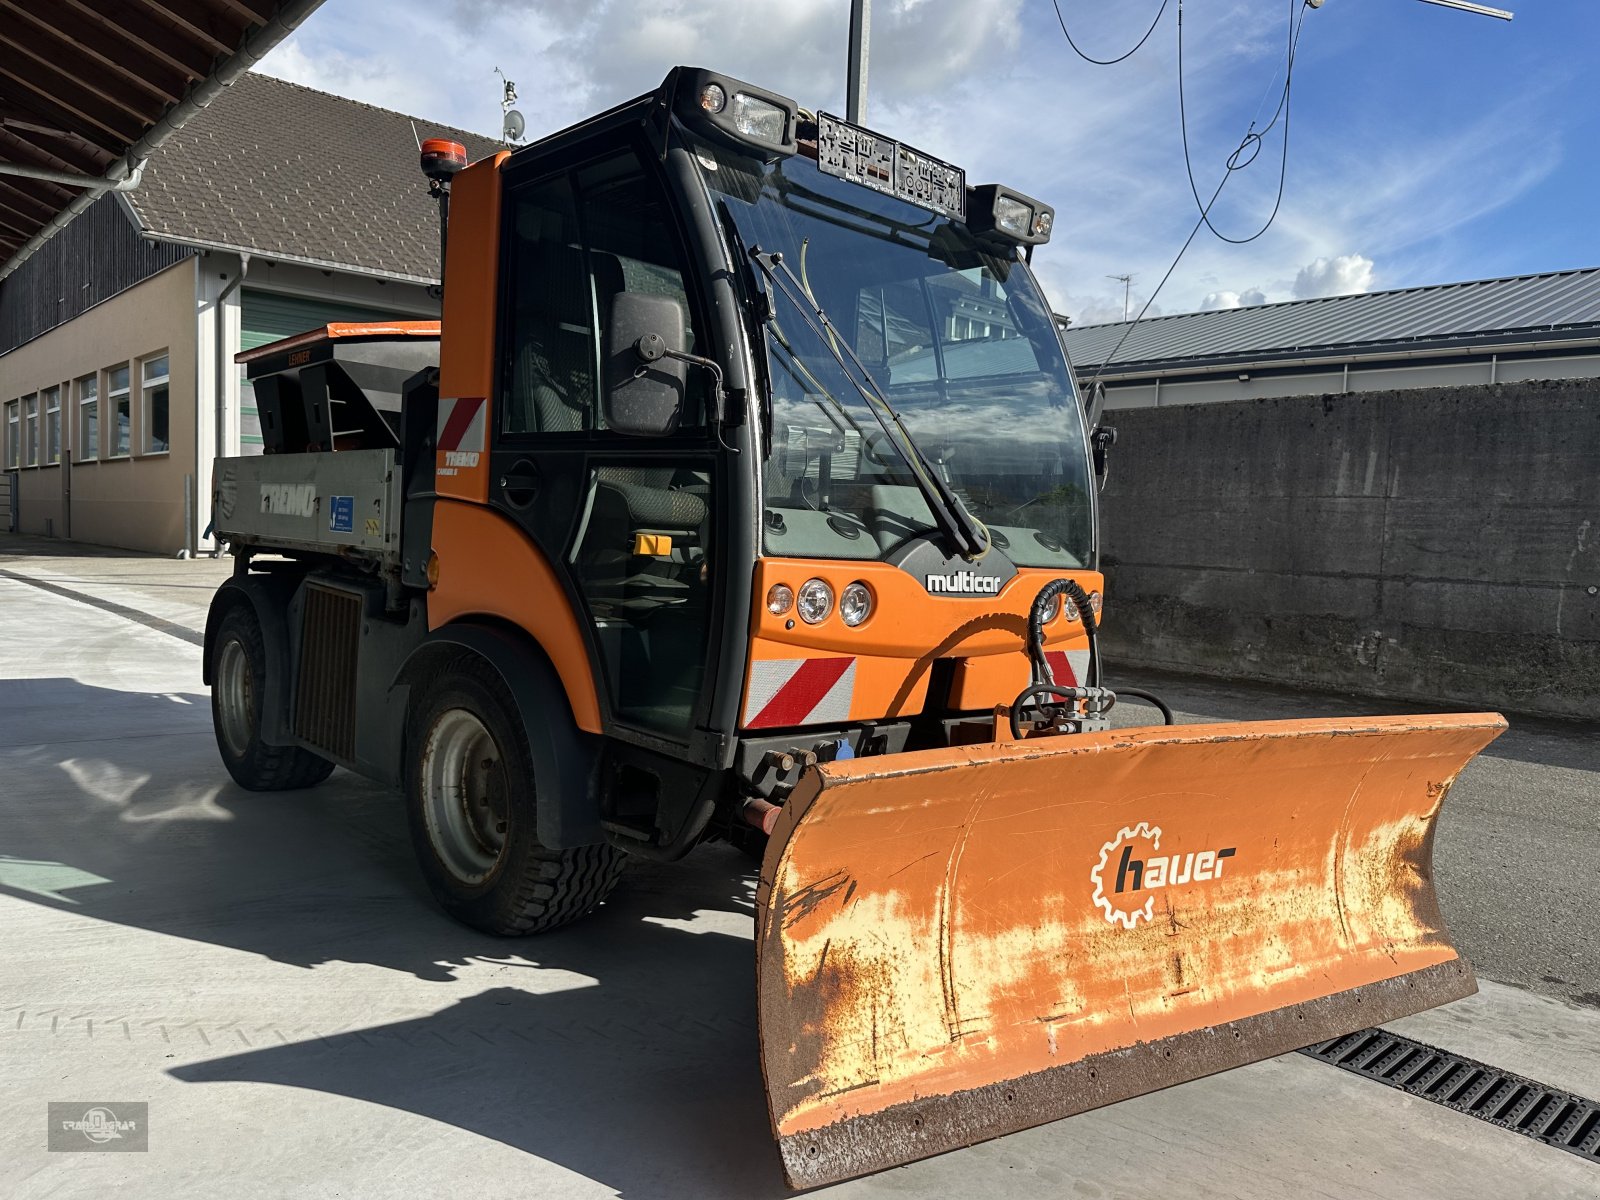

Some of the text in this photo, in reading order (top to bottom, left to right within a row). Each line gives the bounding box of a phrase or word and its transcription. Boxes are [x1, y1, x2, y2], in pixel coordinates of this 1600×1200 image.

[288, 351, 311, 366] LEHNER
[445, 451, 479, 467] TREMO
[259, 482, 317, 518] TREMO
[926, 571, 1001, 593] multicar
[1115, 846, 1237, 893] hauer
